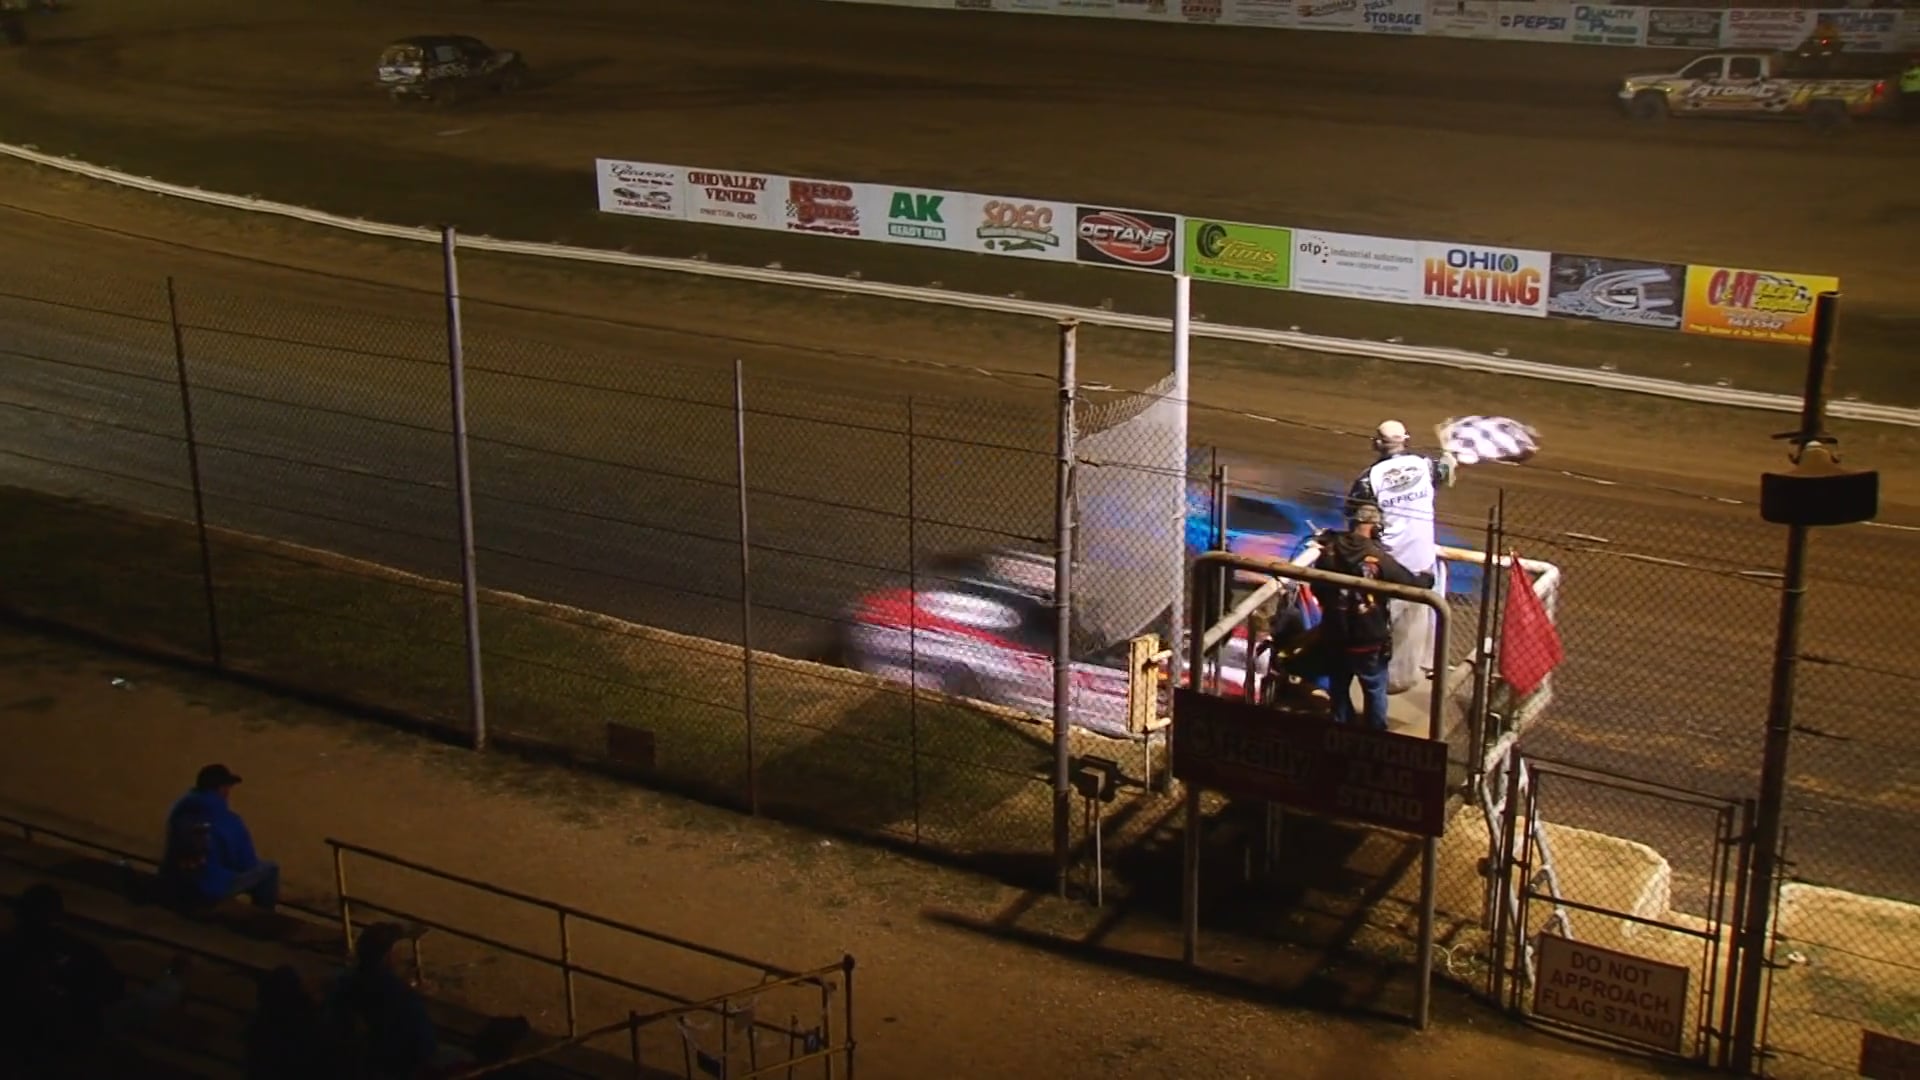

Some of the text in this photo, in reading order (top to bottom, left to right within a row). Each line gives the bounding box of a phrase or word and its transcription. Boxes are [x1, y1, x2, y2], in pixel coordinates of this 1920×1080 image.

[1363, 12, 1423, 26] STORAGE
[1512, 15, 1565, 30] PEPSI
[705, 188, 757, 204] VENEER
[718, 175, 768, 191] VALLEY
[888, 191, 945, 223] AK
[1079, 222, 1170, 245] OCTANE
[1299, 243, 1322, 255] otp
[1446, 248, 1519, 273] OHIO
[1424, 257, 1541, 307] HEATING
[1324, 726, 1443, 771] OFFICIAL
[1348, 759, 1412, 793] FLAG
[1337, 782, 1424, 822] STAND
[1571, 950, 1652, 987] DO NOT
[1550, 968, 1669, 1015] APPROACH
[1541, 987, 1675, 1039] FLAG STAND
